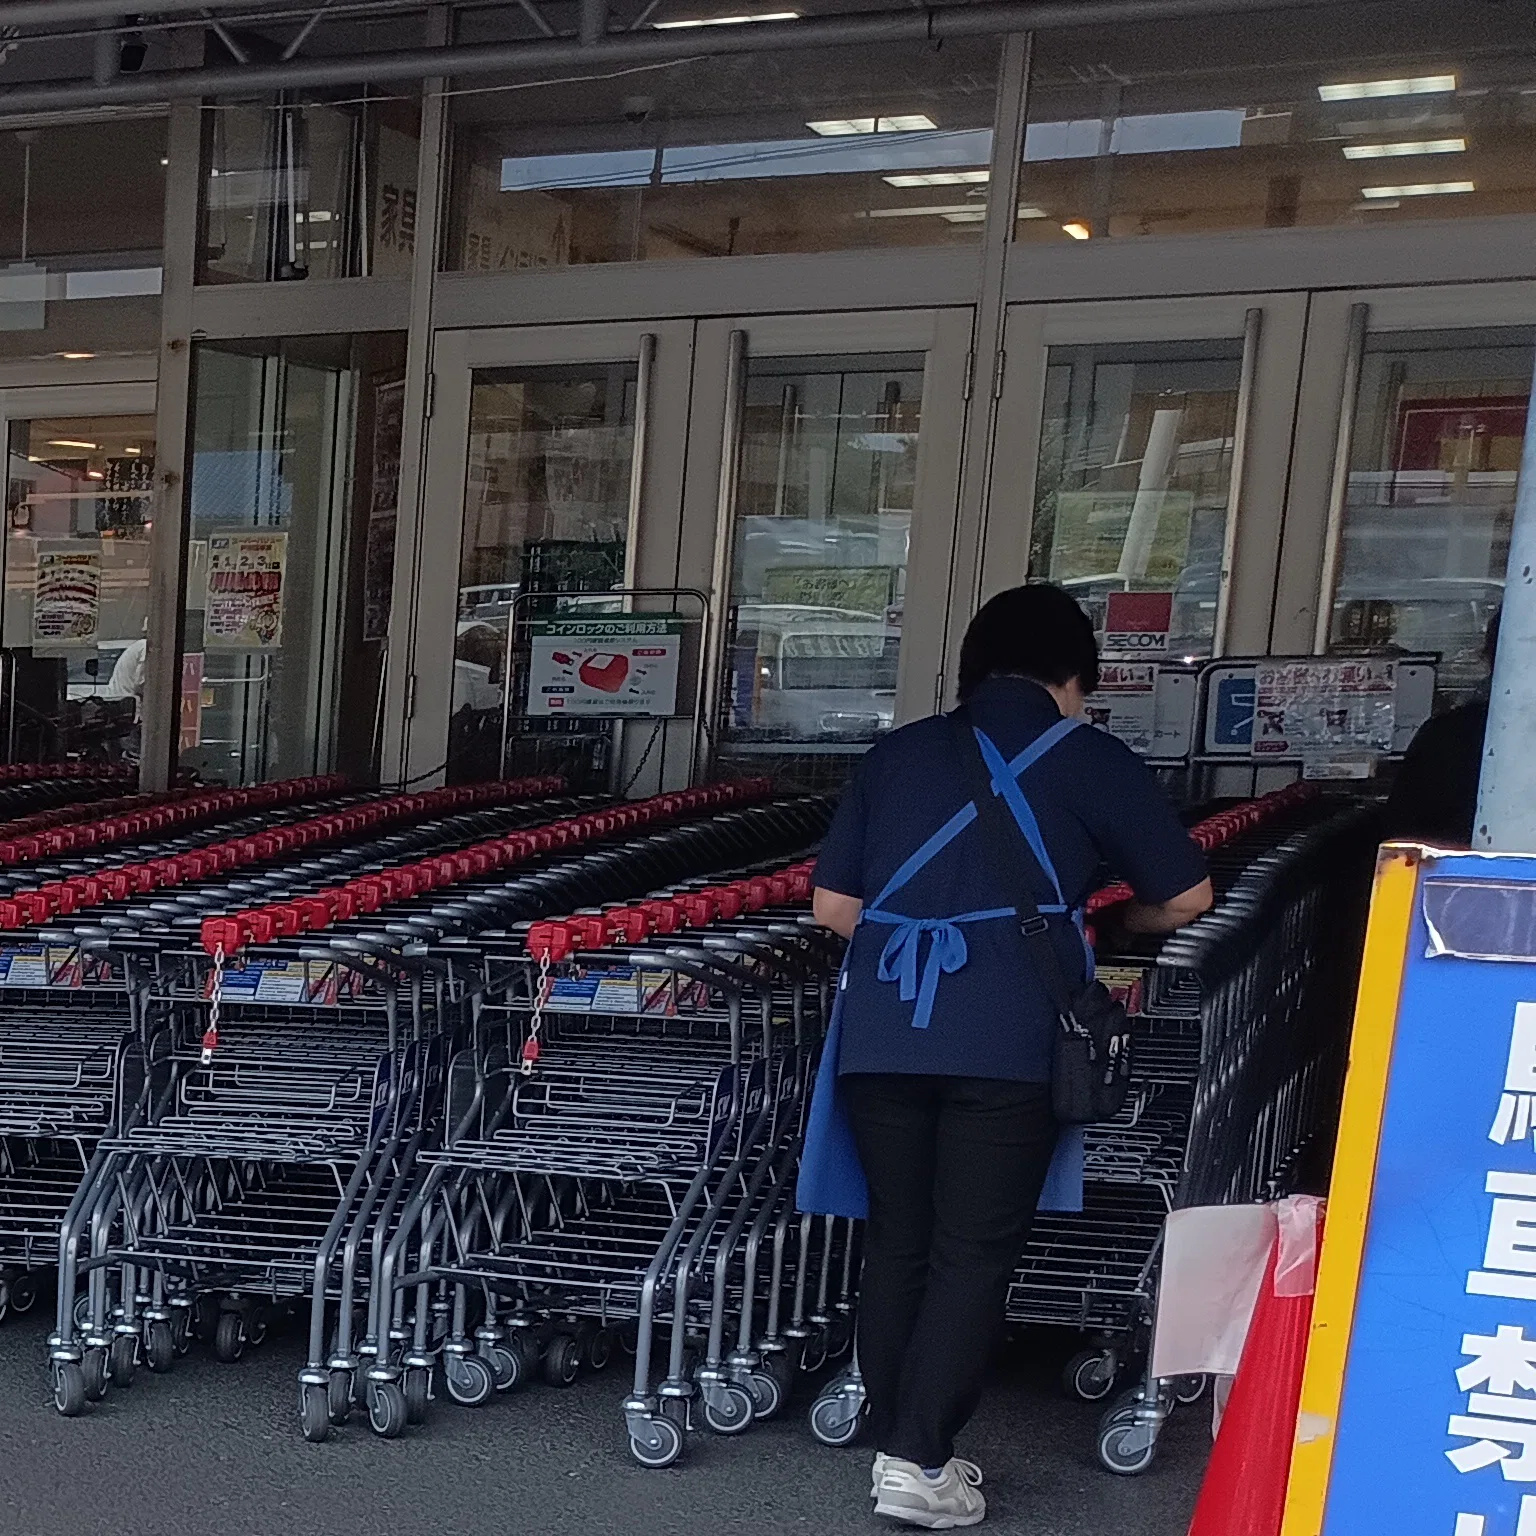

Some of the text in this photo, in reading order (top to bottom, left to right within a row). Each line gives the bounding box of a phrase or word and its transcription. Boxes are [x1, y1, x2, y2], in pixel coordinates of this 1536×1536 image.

[546, 623, 668, 635] コインロックのご利用方法
[1105, 633, 1166, 647] SECOM
